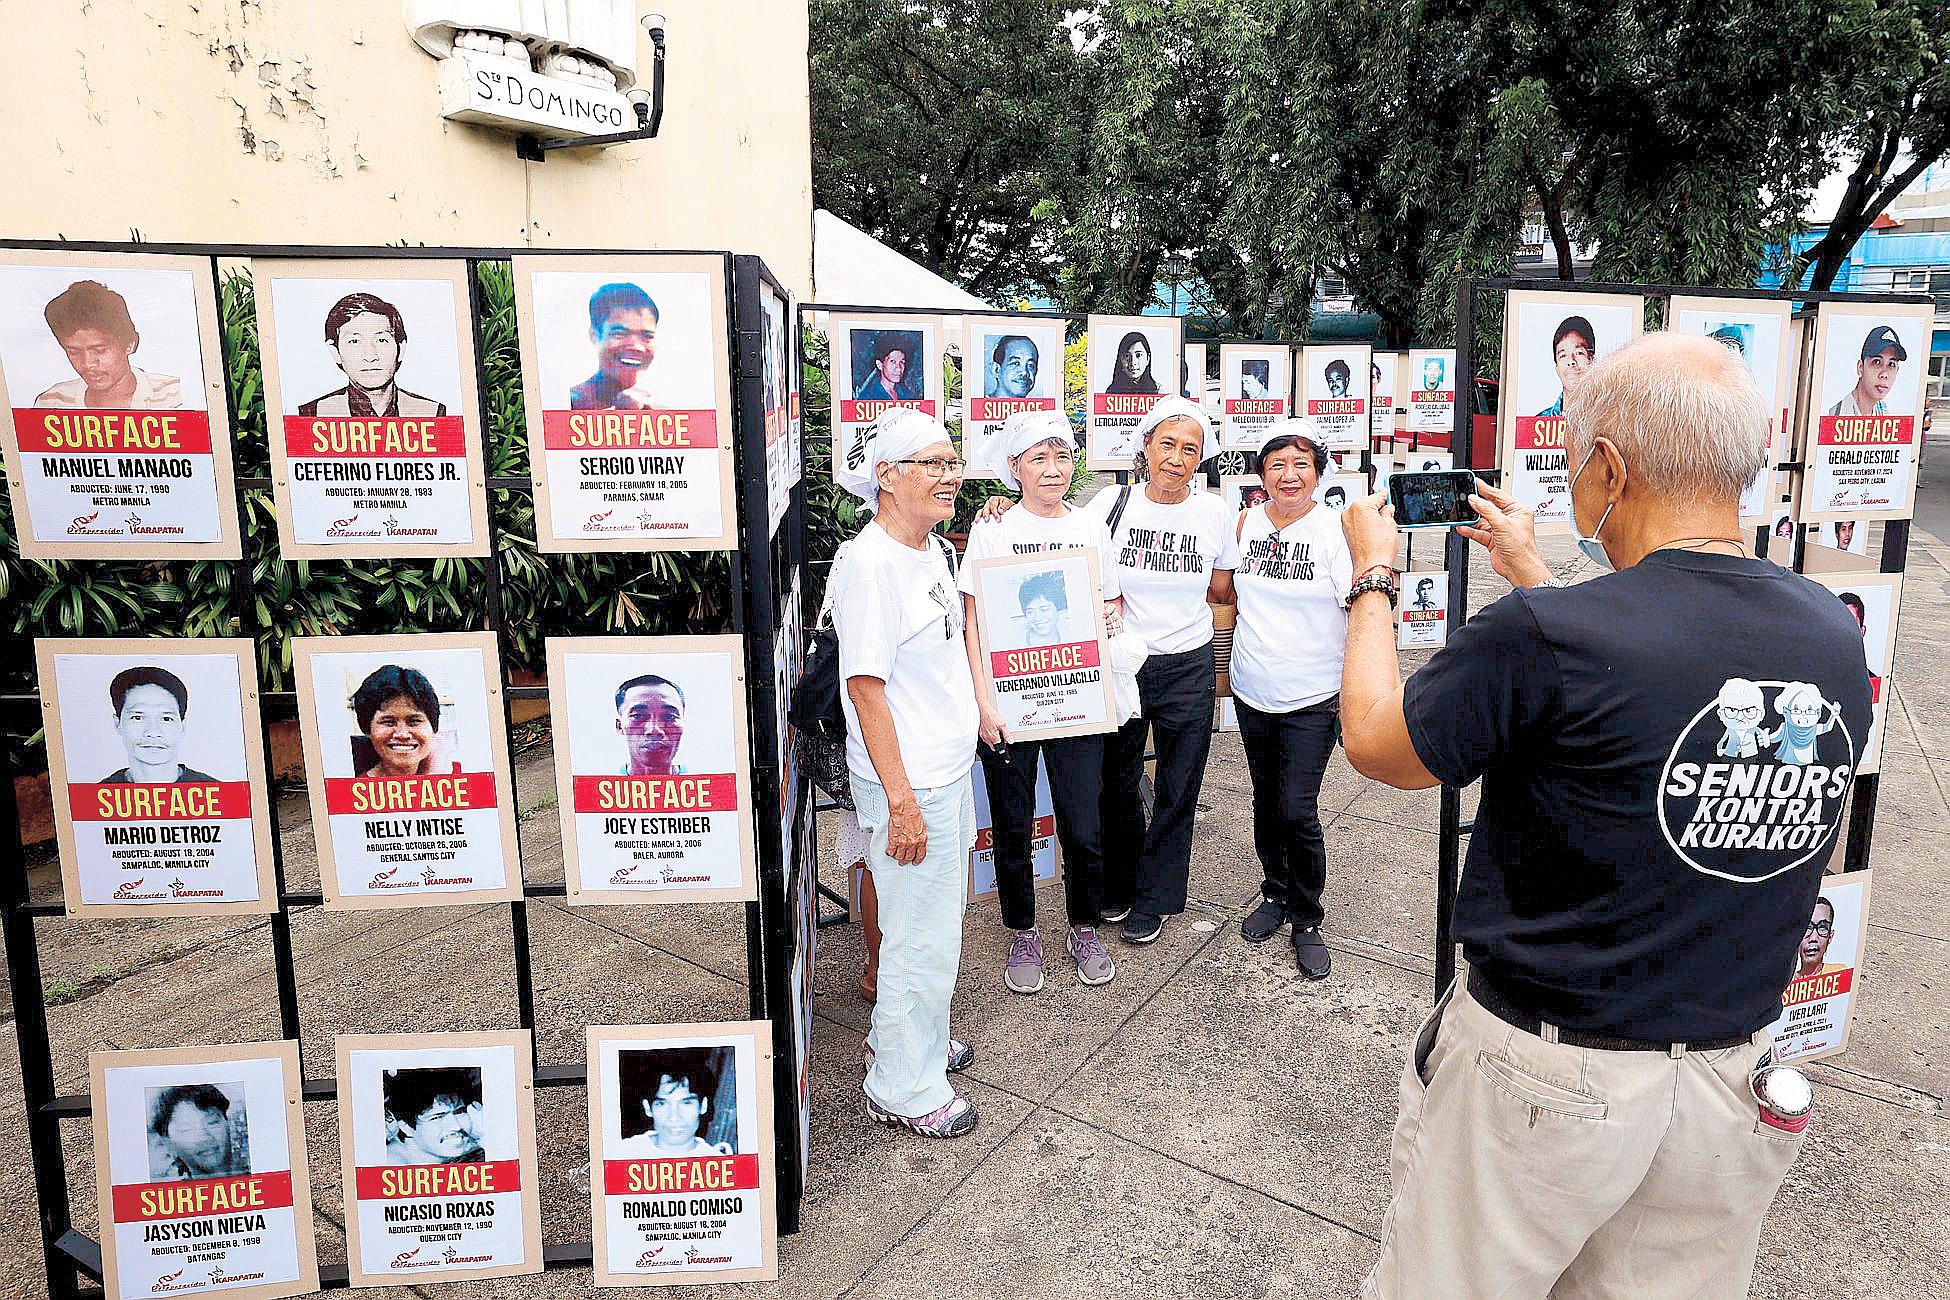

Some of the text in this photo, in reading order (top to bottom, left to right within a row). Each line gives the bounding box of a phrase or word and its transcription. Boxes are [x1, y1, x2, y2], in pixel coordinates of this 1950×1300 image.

[507, 76, 622, 126] DOMINGO
[1106, 396, 1160, 412] SURFAC
[1418, 392, 1448, 401] SURFACE
[1235, 401, 1274, 413] SURFACE
[1317, 401, 1356, 413] SURFACE
[570, 414, 691, 446] SURFACE
[1095, 418, 1118, 427] LETICIA
[1834, 419, 1901, 443] SURFACE
[44, 415, 180, 448] SURFACE
[312, 421, 437, 453] SURFACE
[1829, 450, 1900, 464] GERALD GESTOLE
[42, 458, 193, 478] MANUEL MANAOG
[295, 463, 461, 481] CEFERINO FLORES JR.
[580, 457, 684, 475] SERGIO VIRAY
[70, 485, 169, 495] ABDUCTED: JUNE 17, 1990
[325, 488, 366, 496] ABDUCTED:
[367, 488, 399, 496] JANUARY
[620, 481, 655, 489] FEBRUARY
[93, 497, 150, 506] METRO MANILA
[380, 501, 407, 509] MANILA
[640, 493, 664, 501] SAMAR
[1180, 535, 1198, 554] ALL
[1292, 543, 1309, 561] ALL
[1410, 611, 1438, 621] SURFACE
[1008, 646, 1083, 674] SURFACE
[996, 670, 1100, 692] VENERANDO VILLACILLO
[1666, 763, 1850, 799] SENIORS
[97, 787, 221, 817] SURFACE
[352, 778, 470, 811] SURFACE
[599, 779, 712, 809] SURFACE
[1692, 797, 1823, 825] KONTRA
[365, 818, 465, 838] NELLY INTISE
[604, 817, 711, 835] JOEY ESTRIBER
[104, 826, 221, 845] MARIO DETROZ
[1679, 823, 1828, 851] KURAKOT
[367, 843, 404, 852] ABDUCTED:
[405, 842, 435, 851] OCTOBER
[615, 841, 650, 849] ABDUCTED:
[652, 840, 674, 848] MARCH
[112, 850, 152, 858] ABDUCTED:
[197, 849, 215, 857] 2004
[381, 852, 456, 862] GENERAL SANTOS CITY
[658, 851, 684, 859] AURORA
[122, 860, 209, 870] SAMPALOC, MANILA CITY
[428, 877, 472, 885] KARAPATAN
[1789, 1003, 1828, 1022] IVER LARIT
[382, 1165, 495, 1196] SURFACE
[628, 1160, 735, 1191] SURFACE
[141, 1179, 264, 1216] SURFACE
[384, 1201, 495, 1222] NICASIO ROXAS
[623, 1197, 742, 1219] RONALDO COMISO
[144, 1214, 266, 1242] JASYSON NIEVA
[388, 1225, 425, 1234] ABDUCTED:
[426, 1224, 462, 1232] NOVEMBER
[638, 1223, 672, 1231] ABDUCTED:
[674, 1221, 697, 1230] AUGUST
[420, 1234, 446, 1242] QUEZON
[646, 1232, 681, 1241] SAMPALOC,
[683, 1232, 706, 1240] MANILA
[152, 1245, 191, 1255] ABDUCTED:
[192, 1241, 232, 1252] DECEMBER
[187, 1252, 226, 1263] BATANGAS
[449, 1255, 492, 1263] KARAPATAN
[216, 1272, 264, 1284] KARAPATAN
